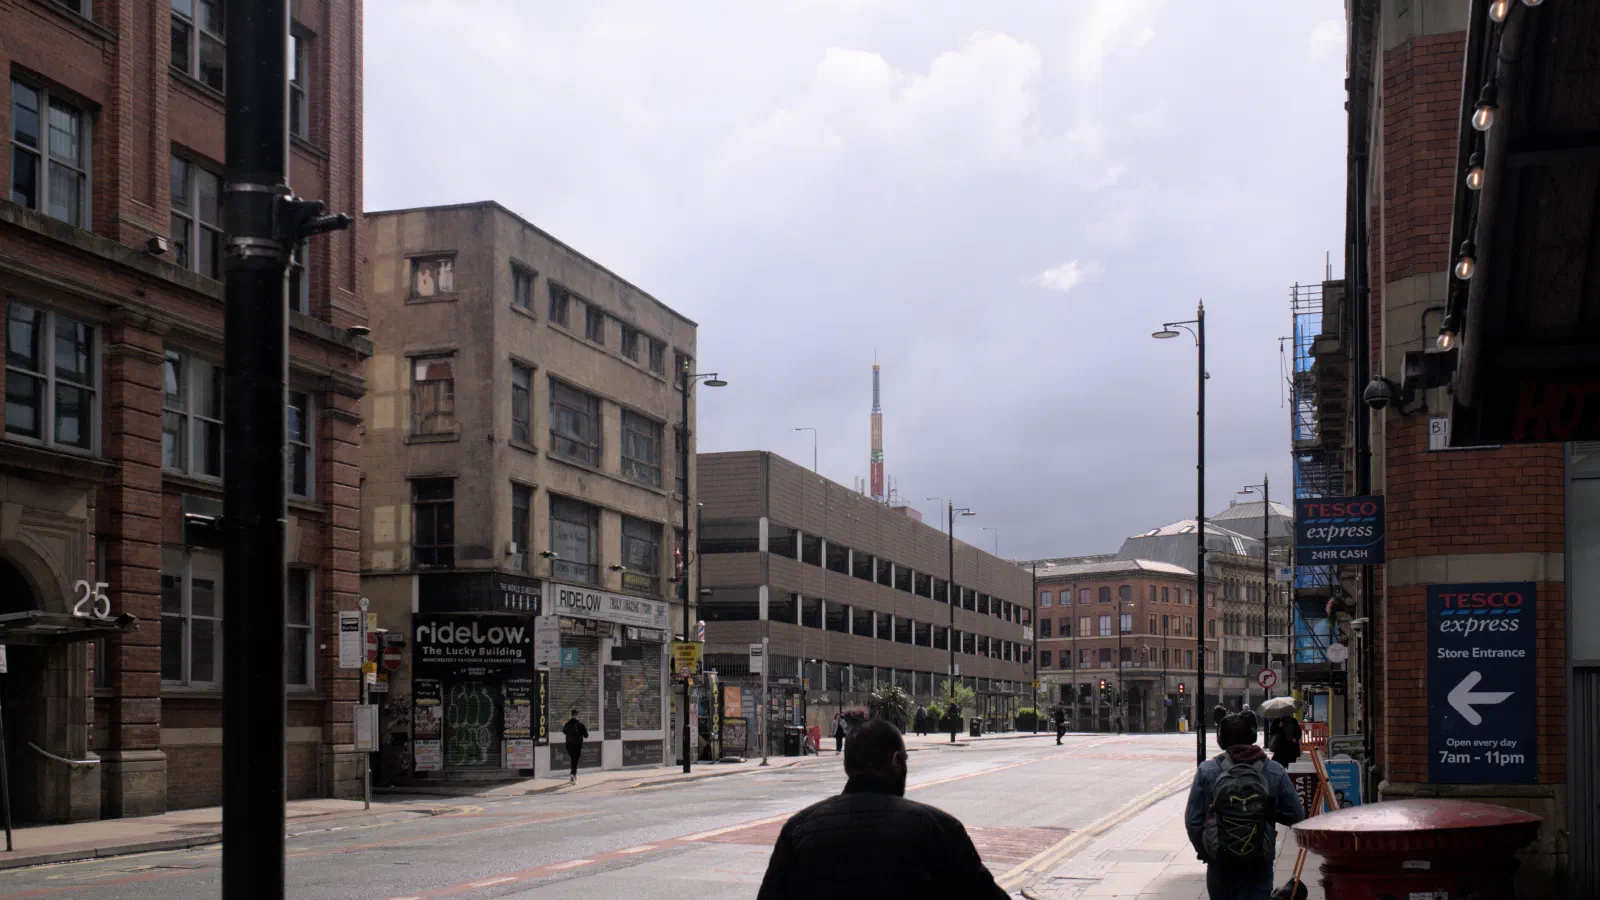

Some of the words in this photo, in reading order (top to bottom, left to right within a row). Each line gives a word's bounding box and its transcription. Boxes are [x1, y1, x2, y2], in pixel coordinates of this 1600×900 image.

[1303, 502, 1377, 518] TESCO
[1306, 525, 1373, 542] express
[1311, 549, 1337, 560] 24HR
[1339, 549, 1368, 560] CASH
[72, 579, 111, 619] 25
[560, 589, 602, 612] RIDELOW
[1438, 592, 1523, 609] TESCO
[416, 621, 530, 645] ridelow.
[1439, 617, 1520, 638] express
[422, 646, 442, 655] The
[446, 646, 476, 657] Lucky
[478, 647, 522, 657] Building
[1437, 647, 1470, 659] Store
[1472, 647, 1526, 659] Entrance
[710, 674, 719, 734] TATTOO
[1446, 738, 1471, 749] Open
[1473, 740, 1498, 750] every
[1499, 738, 1517, 750] day
[1439, 751, 1471, 765] 7am
[1484, 751, 1525, 768] 11pm
[1295, 776, 1306, 809] OSTA
